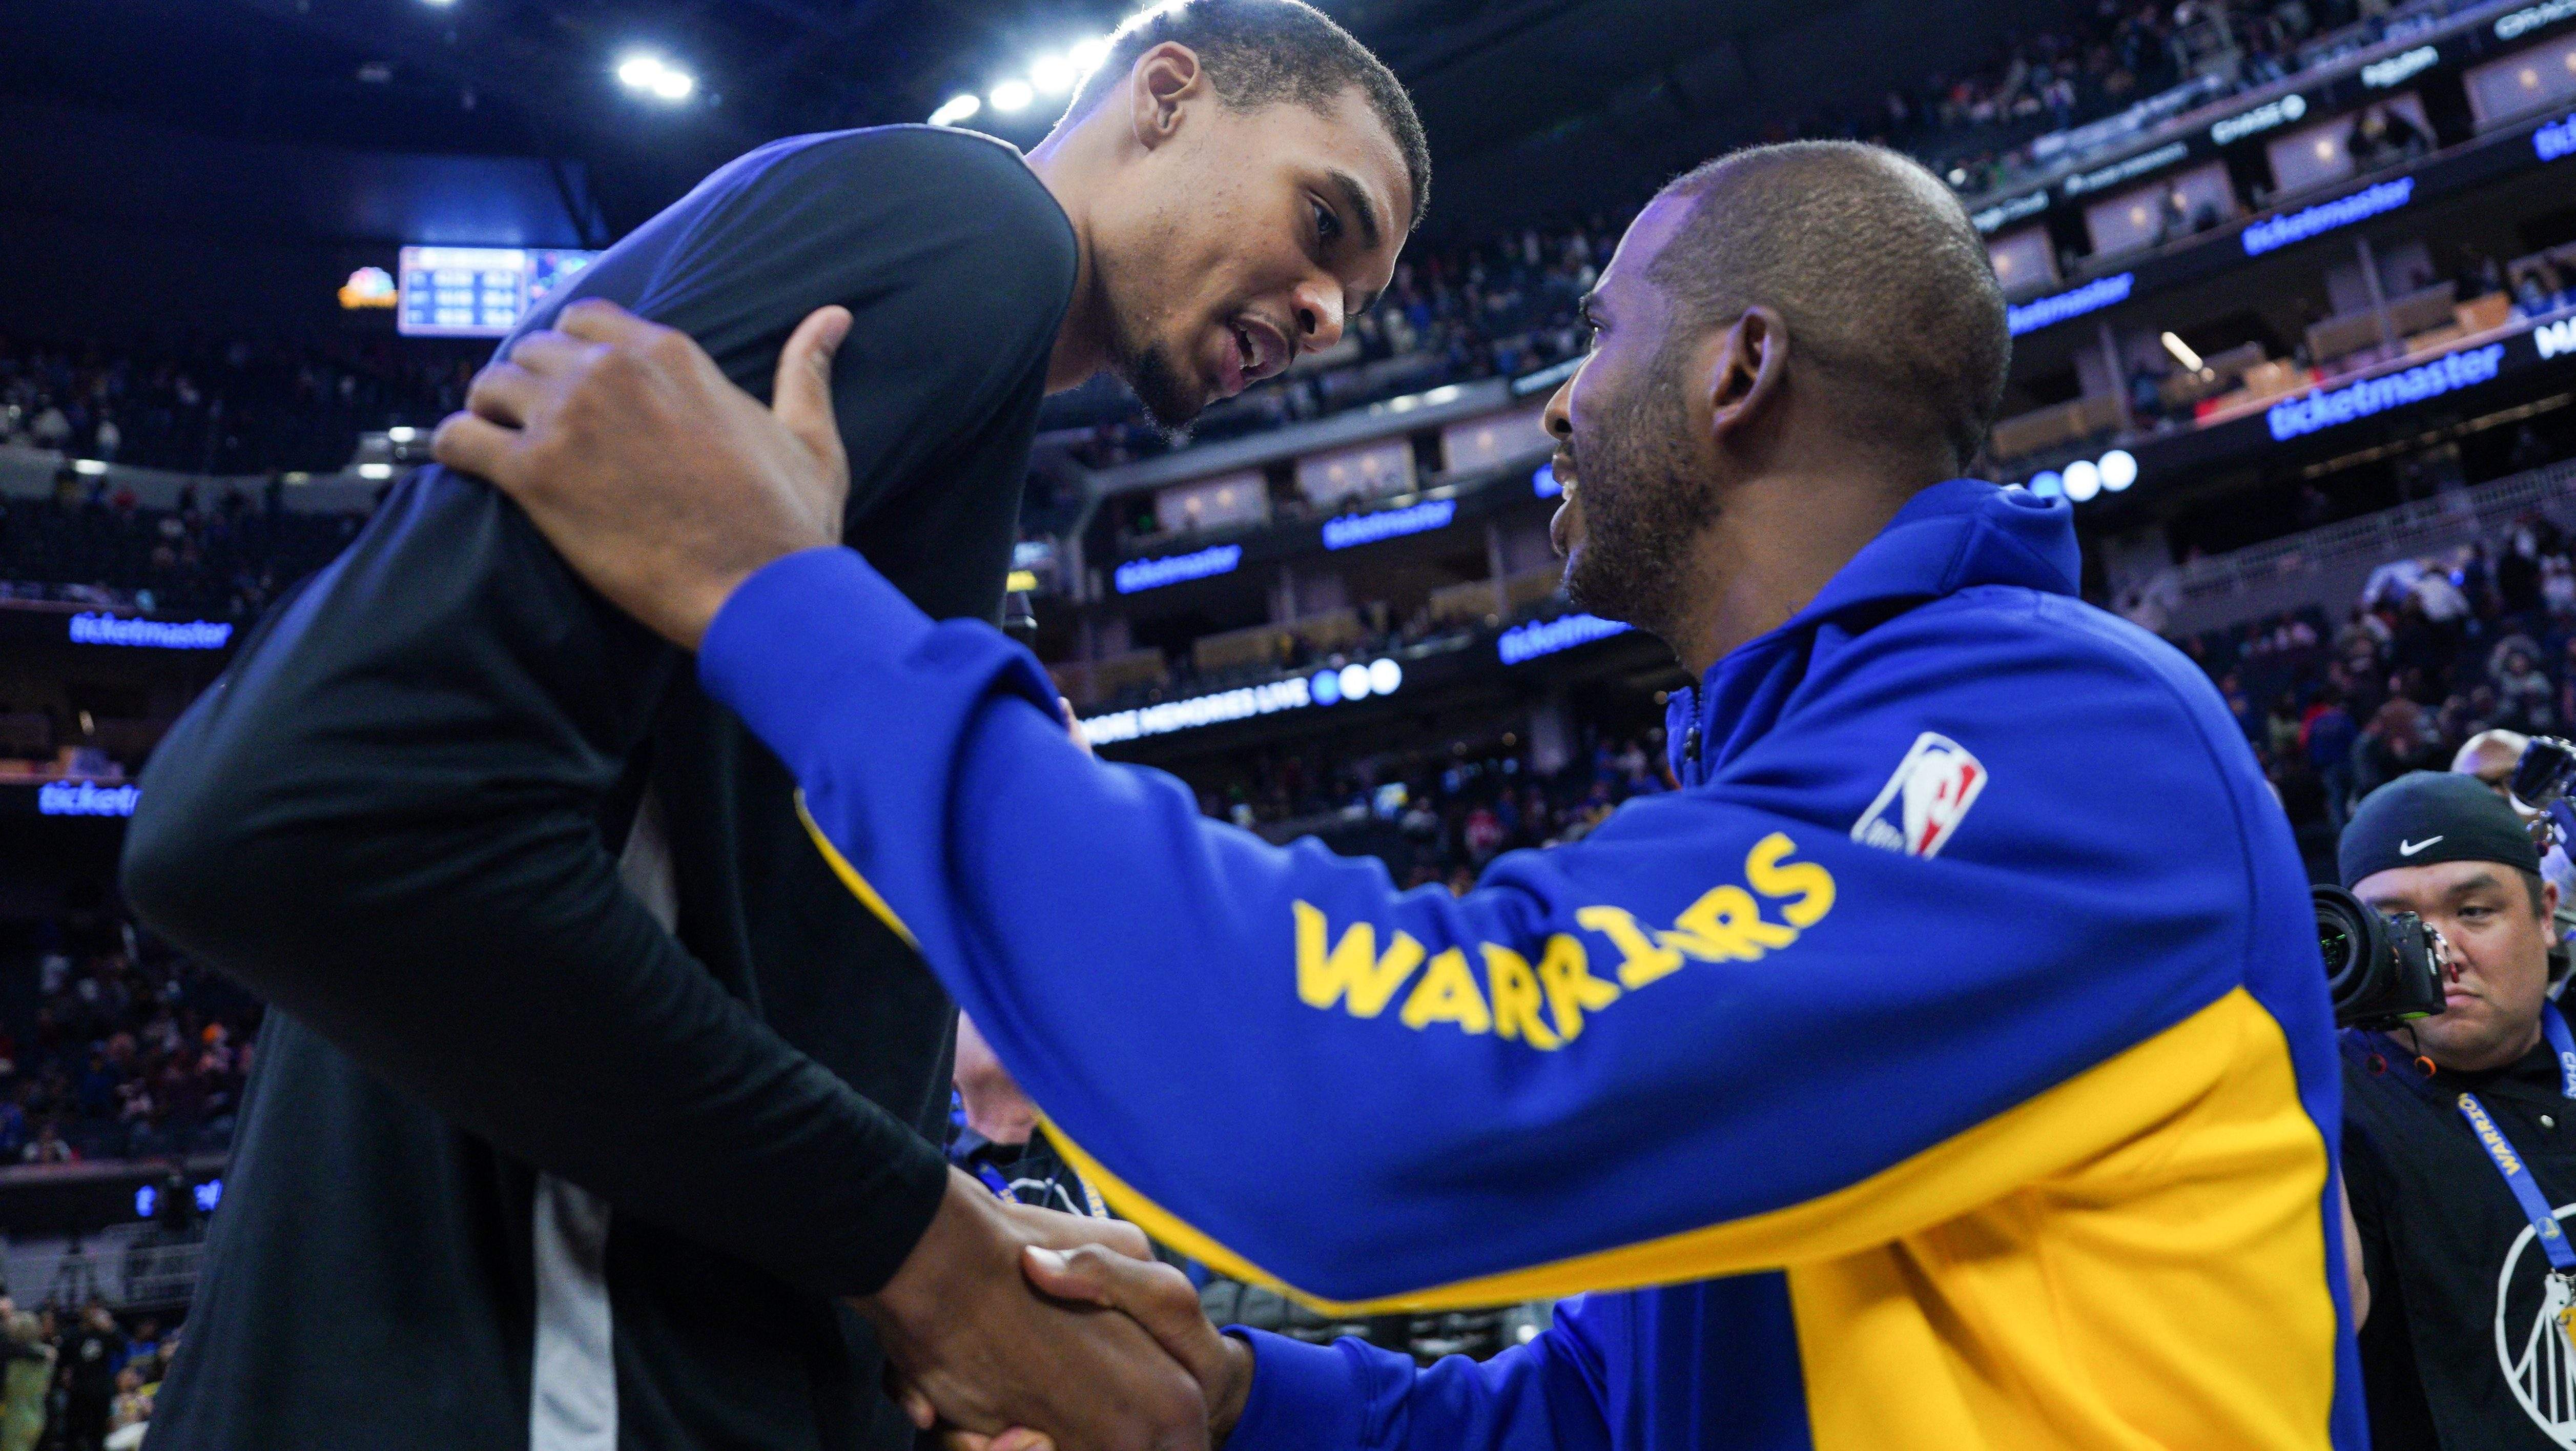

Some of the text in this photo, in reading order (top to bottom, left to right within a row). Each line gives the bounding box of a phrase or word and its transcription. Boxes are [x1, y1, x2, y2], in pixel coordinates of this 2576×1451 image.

[2241, 177, 2414, 256] ticketmaster
[2006, 272, 2134, 338] ketmaster
[2266, 343, 2505, 441] ticketmaster
[1322, 497, 1457, 550] ticketmaster
[1115, 544, 1242, 594] ticketmaster
[70, 611, 233, 649] ticketmaster
[1255, 677, 1311, 713] LIVE
[38, 780, 143, 816] ticket
[1293, 832, 1836, 1051] WARRIRS
